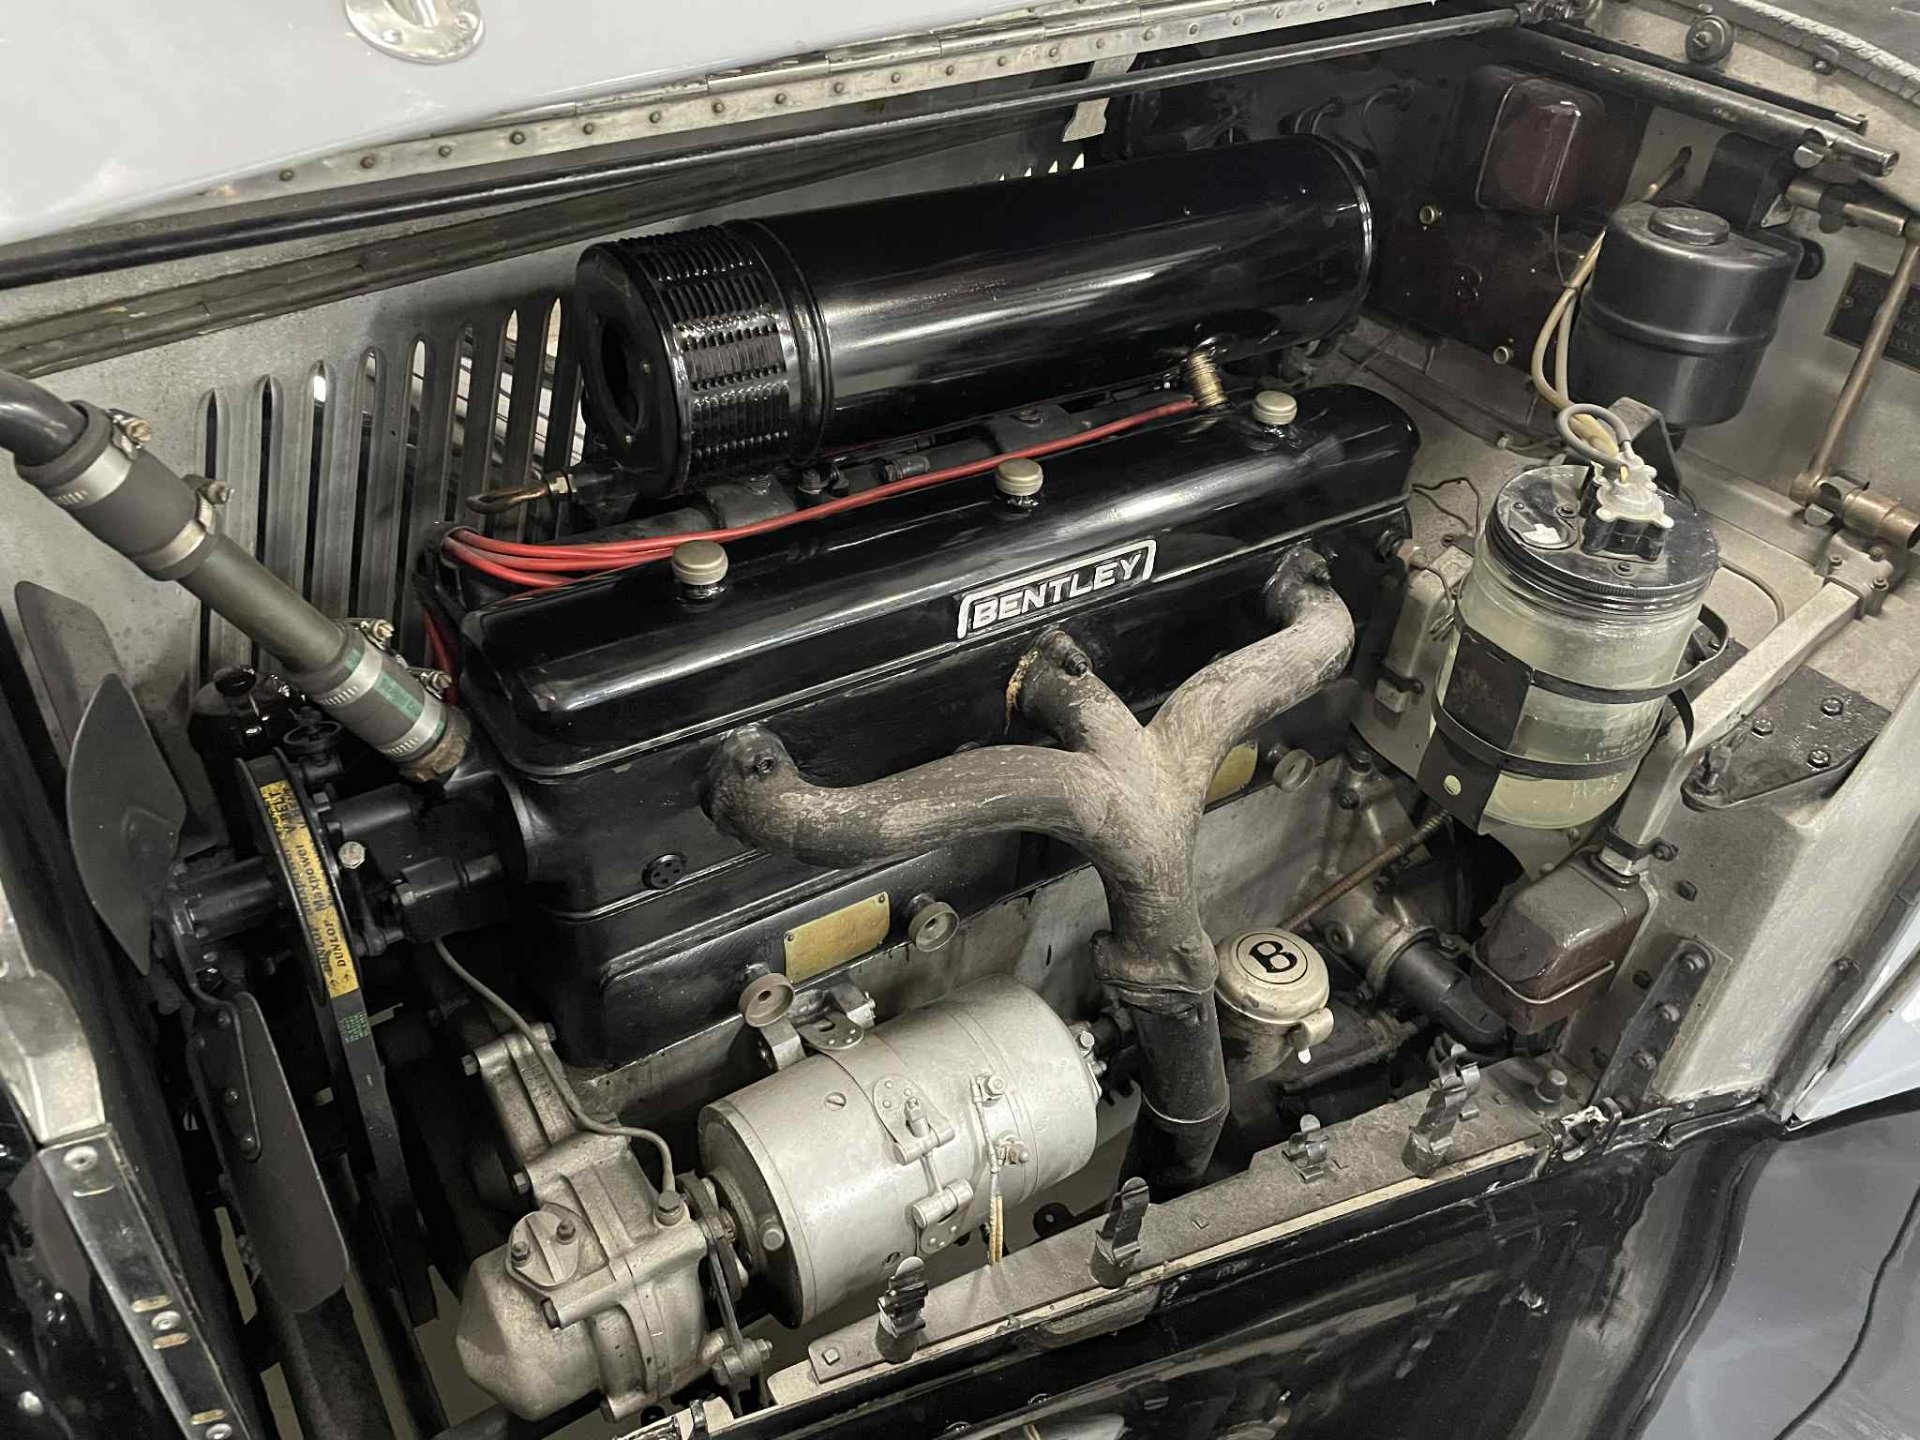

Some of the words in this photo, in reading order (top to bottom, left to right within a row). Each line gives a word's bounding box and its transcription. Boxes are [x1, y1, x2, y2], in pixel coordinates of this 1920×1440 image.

[972, 553, 1142, 630] BENTLEY
[296, 844, 329, 911] Maxpower
[324, 919, 346, 967] DUNLOP
[1249, 941, 1298, 973] B
